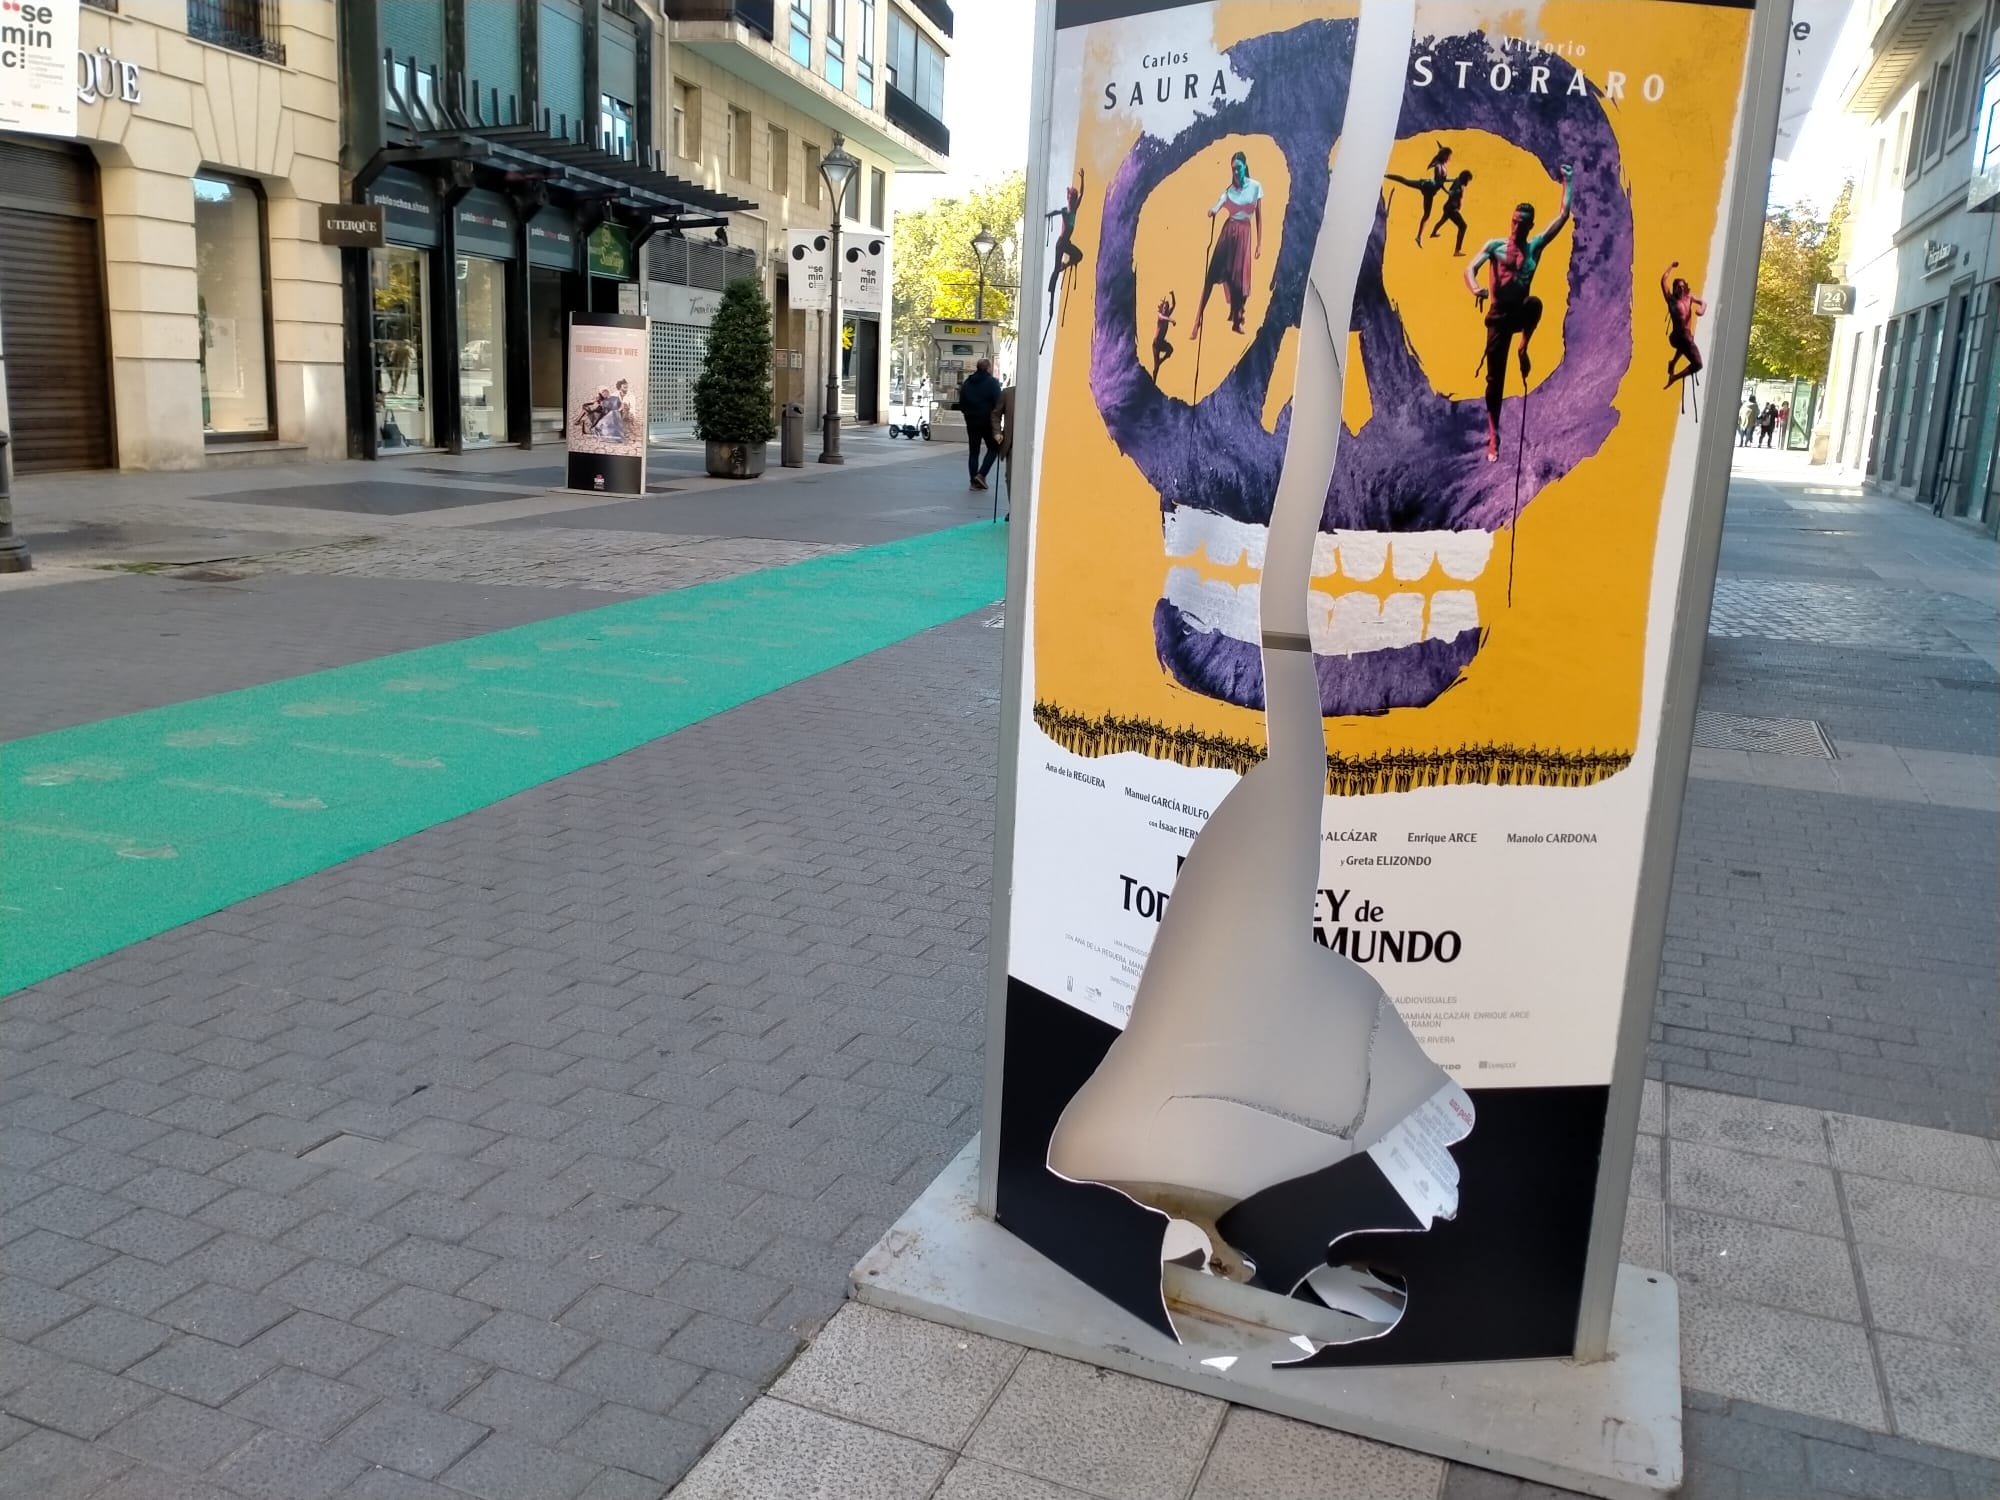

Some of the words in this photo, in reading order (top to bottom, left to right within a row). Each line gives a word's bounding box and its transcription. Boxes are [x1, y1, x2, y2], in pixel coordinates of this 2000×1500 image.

[2, 24, 52, 48] min
[1503, 35, 1587, 57] Vittorio
[1142, 51, 1189, 69] Carlos
[1412, 55, 1665, 101] STORARO
[1103, 69, 1228, 110] SAURA
[1823, 291, 1841, 303] 24
[1045, 761, 1058, 773] Ana
[1058, 766, 1066, 777] de
[1066, 768, 1073, 778] la
[1073, 770, 1106, 789] REGUERA
[1124, 787, 1150, 803] Manuel
[1151, 795, 1181, 812] GARCÍA
[1182, 804, 1209, 821] RULFO
[1149, 820, 1158, 829] con
[1159, 819, 1177, 834] Isaac
[1325, 829, 1378, 842] ALCÁZAR
[1407, 832, 1447, 845] Enrique
[1448, 833, 1478, 843] ARCE
[1506, 833, 1544, 843] Manolo
[1545, 834, 1598, 843] CARDONA
[1340, 859, 1345, 867] y
[1346, 856, 1374, 866] Greta
[1376, 856, 1432, 866] ELIZONDO
[1354, 900, 1384, 923] de
[1473, 1011, 1508, 1020] ENRIQUE
[1509, 1011, 1530, 1019] ARCE
[1427, 1036, 1456, 1044] RIVERA
